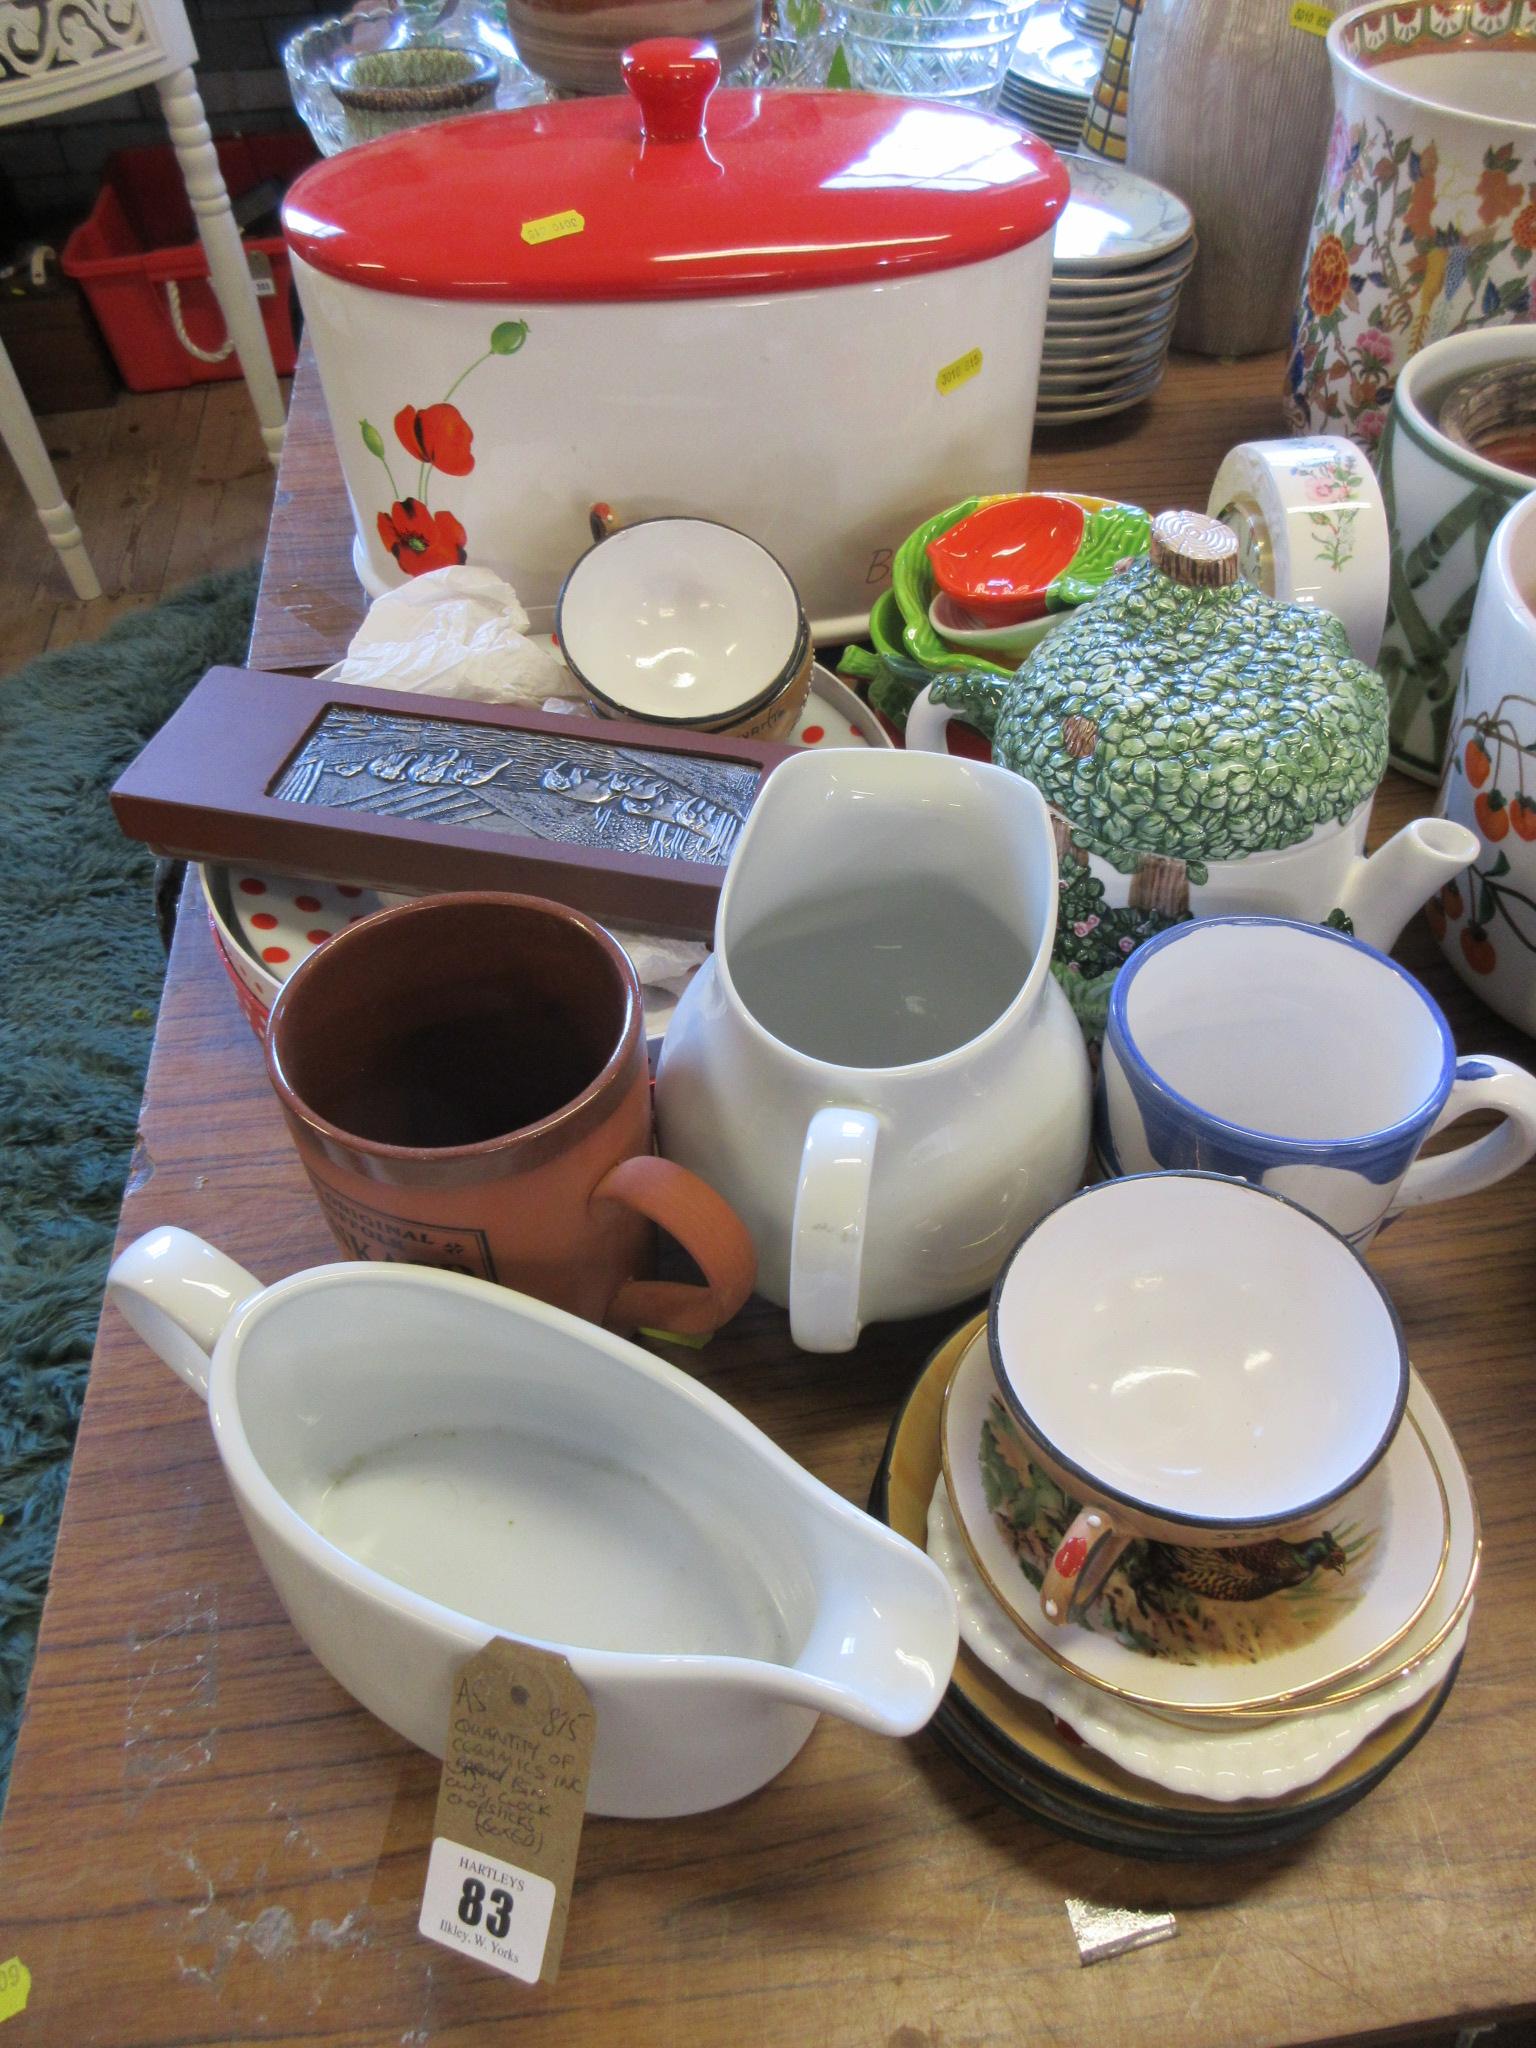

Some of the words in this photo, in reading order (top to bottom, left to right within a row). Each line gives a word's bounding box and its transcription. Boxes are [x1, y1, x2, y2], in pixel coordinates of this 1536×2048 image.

[454, 1718, 541, 1760] QUANTITY
[548, 1753, 575, 1769] OF
[458, 1856, 526, 1892] HARTLEYS
[457, 1876, 515, 1940] 83
[474, 1932, 489, 1951] W.
[490, 1940, 520, 1965] Yorks
